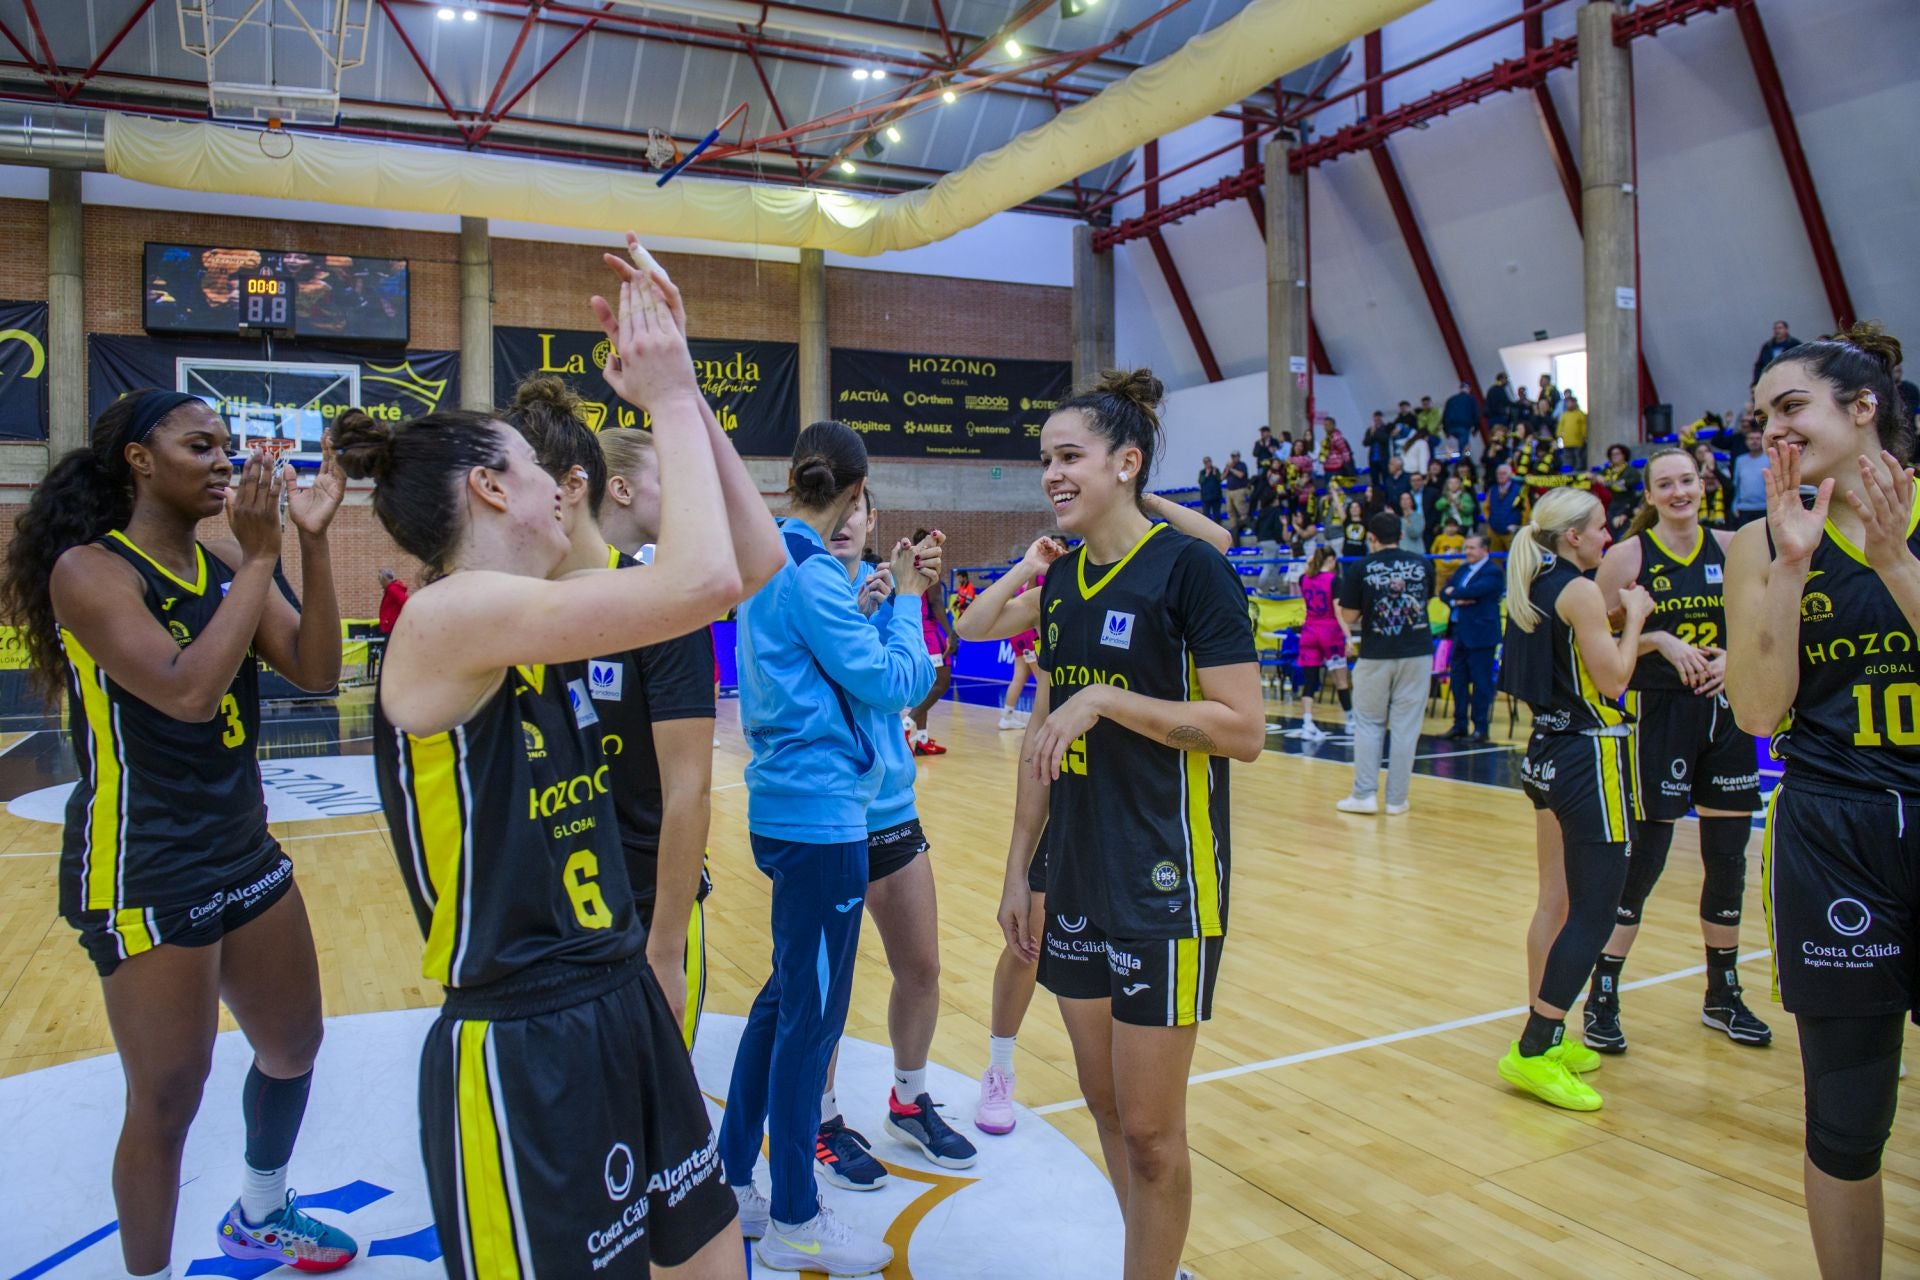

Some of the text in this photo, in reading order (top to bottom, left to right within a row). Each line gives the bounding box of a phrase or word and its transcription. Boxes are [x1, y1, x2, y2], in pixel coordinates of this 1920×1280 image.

[538, 333, 586, 374] La
[908, 358, 996, 377] HOZONO
[941, 378, 968, 386] GLOBAL
[850, 389, 889, 402] ACTÚA
[916, 423, 953, 434] AMBEX
[975, 425, 1011, 434] entorno
[1676, 621, 1719, 648] 22
[1806, 631, 1920, 665] HOZO
[1050, 665, 1128, 690] OZONO
[1865, 664, 1915, 675] GLOBAL
[221, 693, 246, 749] 3
[1852, 683, 1920, 746] 10
[1156, 871, 1177, 881] 1954
[563, 849, 613, 929] 6
[1072, 940, 1106, 953] Cálid
[1802, 941, 1901, 958] Costa Cálida
[1068, 953, 1089, 962] Murcia
[1804, 957, 1874, 969] Región de Murcia
[588, 1196, 649, 1254] Costa Cáli
